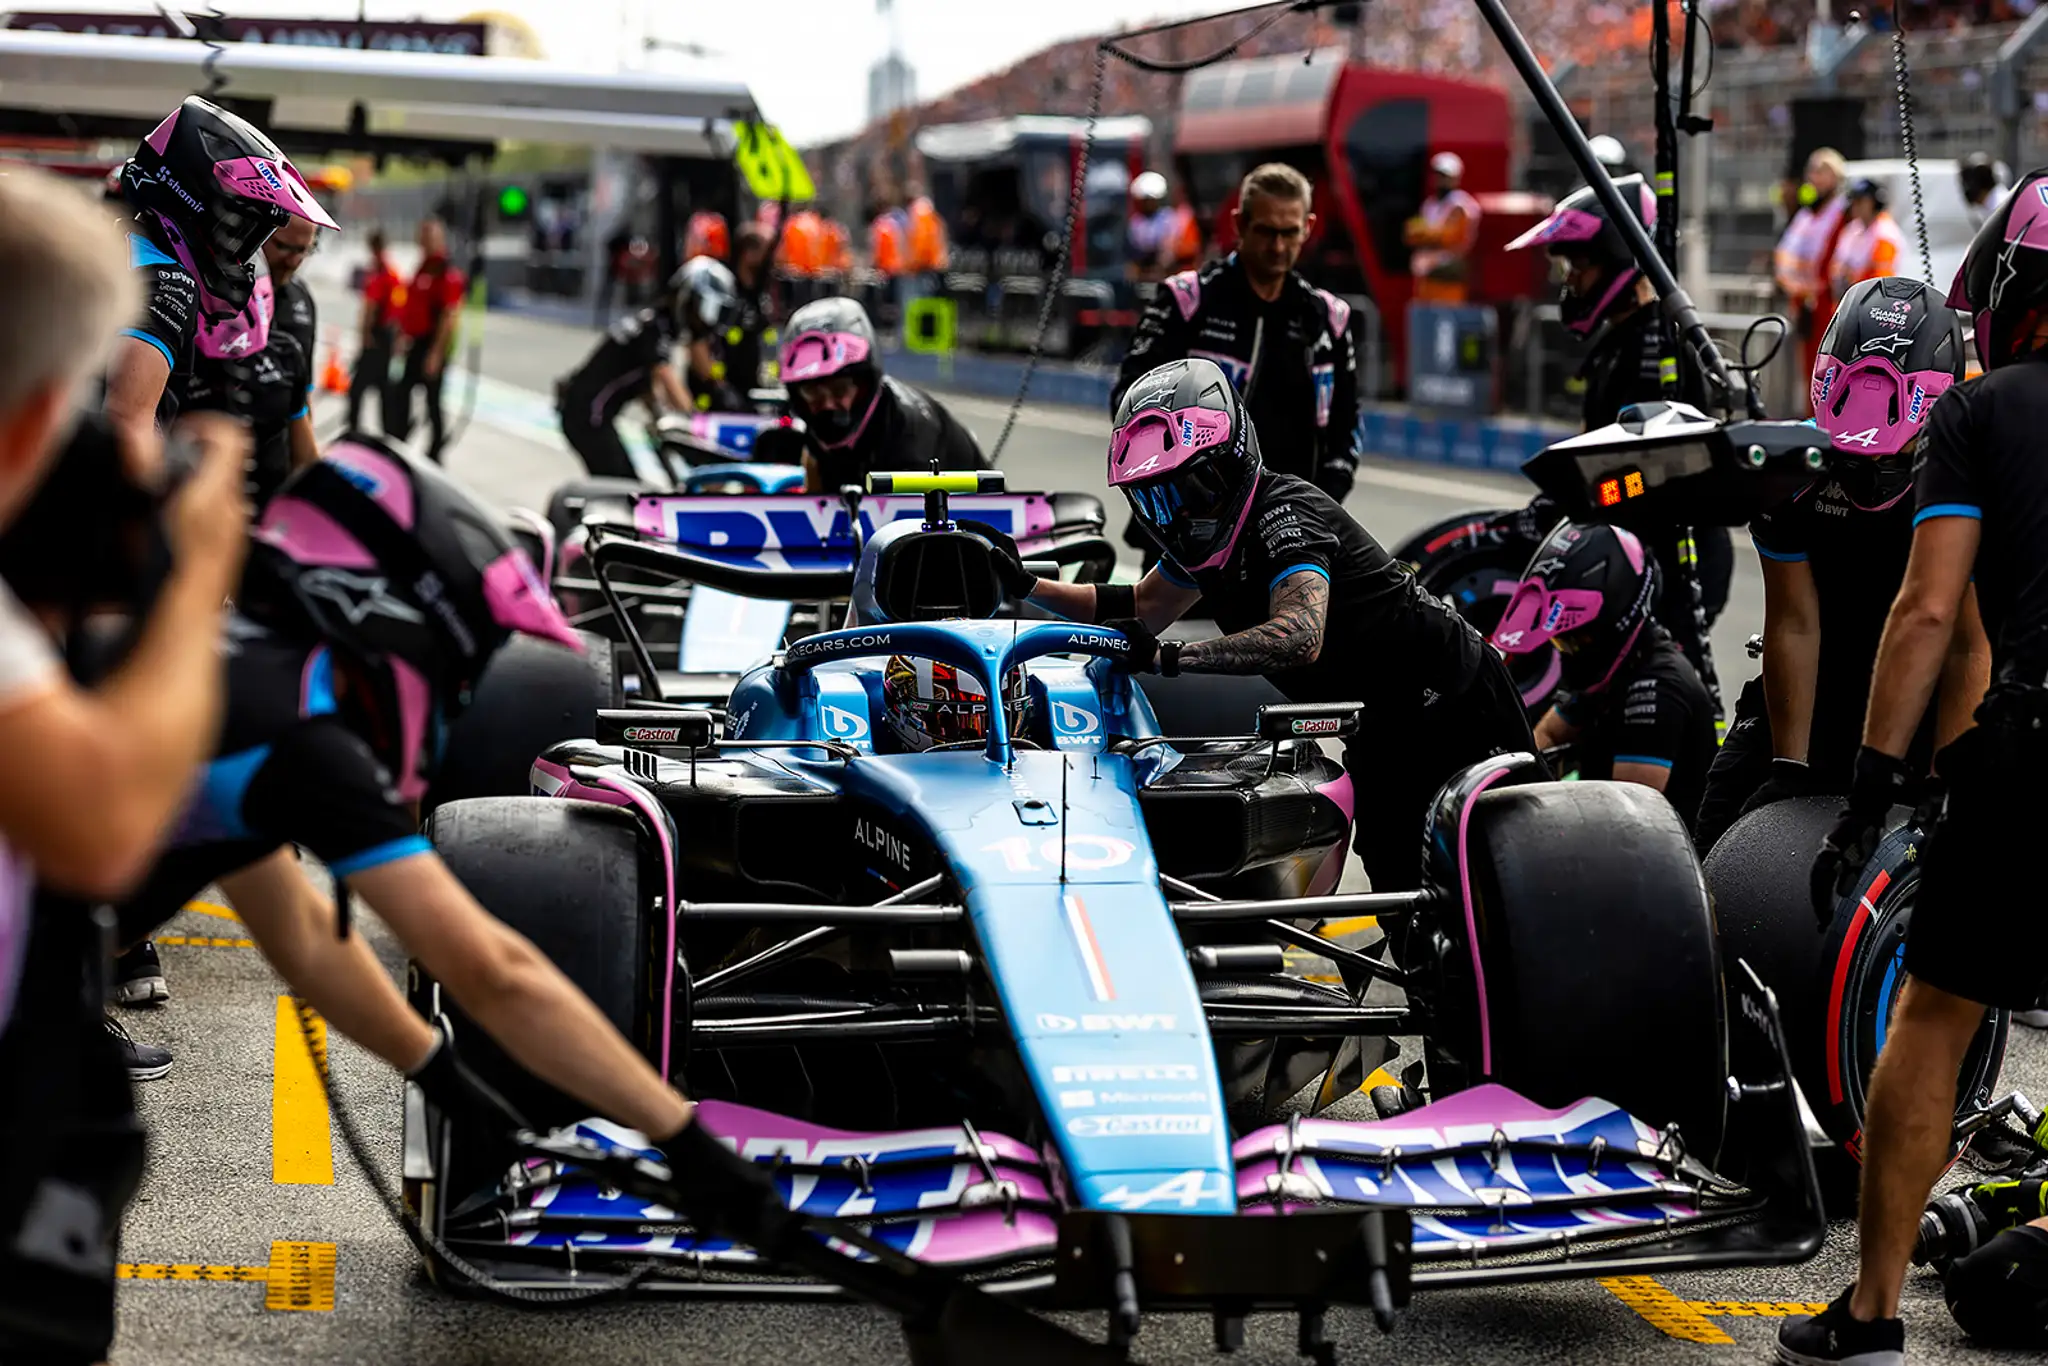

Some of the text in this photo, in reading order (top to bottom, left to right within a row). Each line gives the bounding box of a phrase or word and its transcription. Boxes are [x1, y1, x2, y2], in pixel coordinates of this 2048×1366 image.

[262, 169, 282, 190] BWT
[168, 178, 205, 213] shamir
[1910, 387, 1925, 414] BWT
[1182, 420, 1194, 440] BWT
[1264, 503, 1292, 521] BWT
[1824, 506, 1849, 517] BWT
[1304, 719, 1338, 732] Castrol
[637, 728, 677, 741] Castrol
[1055, 735, 1102, 745] BWT
[854, 817, 911, 872] ALPINE
[980, 834, 1137, 873] 10
[1081, 1014, 1178, 1031] BWT
[1100, 1090, 1207, 1104] Microsoft
[1106, 1116, 1202, 1132] Castrol
